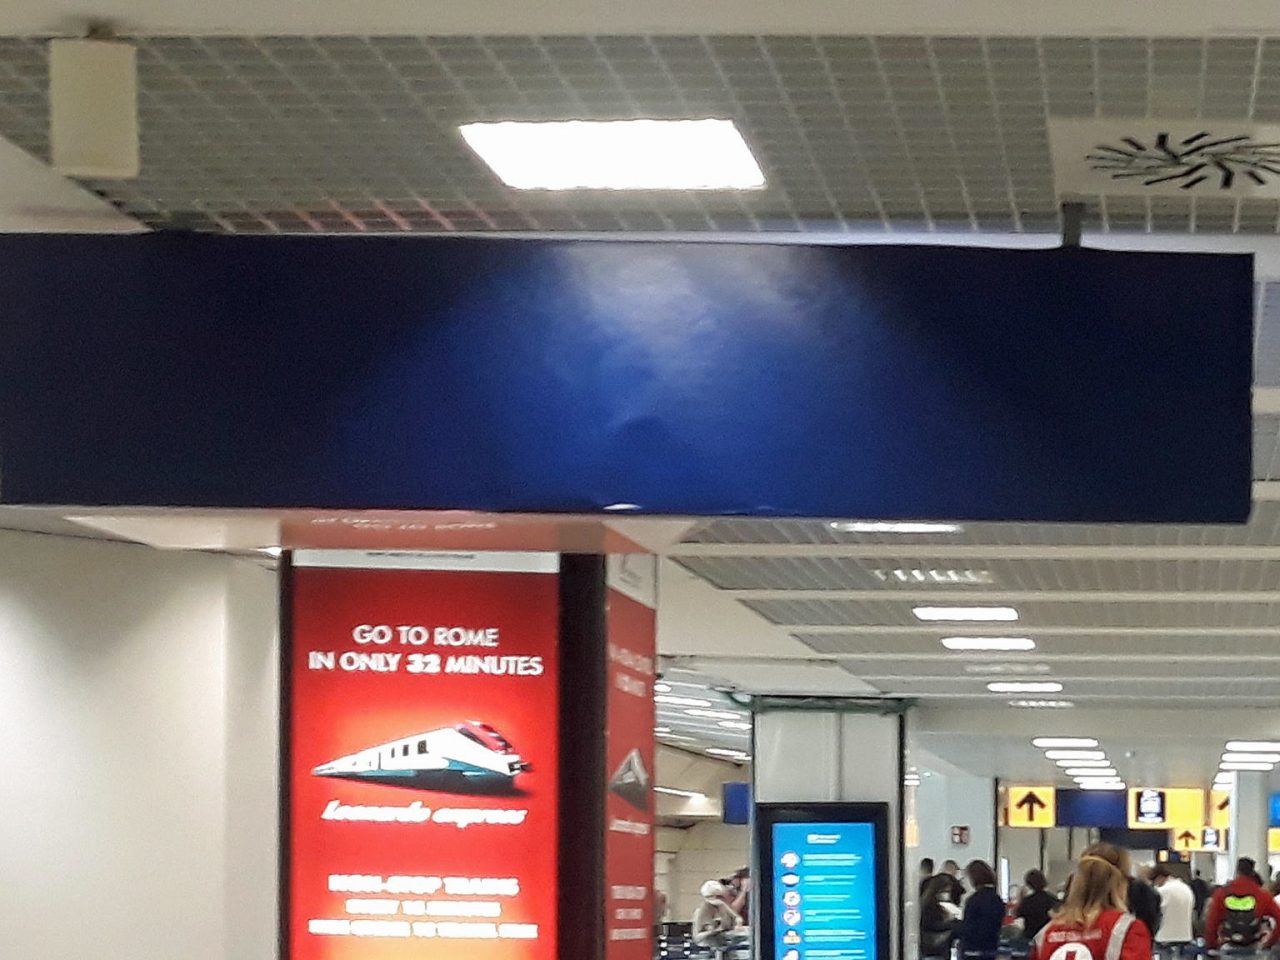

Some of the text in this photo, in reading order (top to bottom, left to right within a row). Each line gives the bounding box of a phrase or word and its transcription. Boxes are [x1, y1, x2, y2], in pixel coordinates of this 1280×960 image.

[352, 624, 499, 647] GO TO ROME
[308, 650, 544, 675] IN ONLY 32 MINUTES
